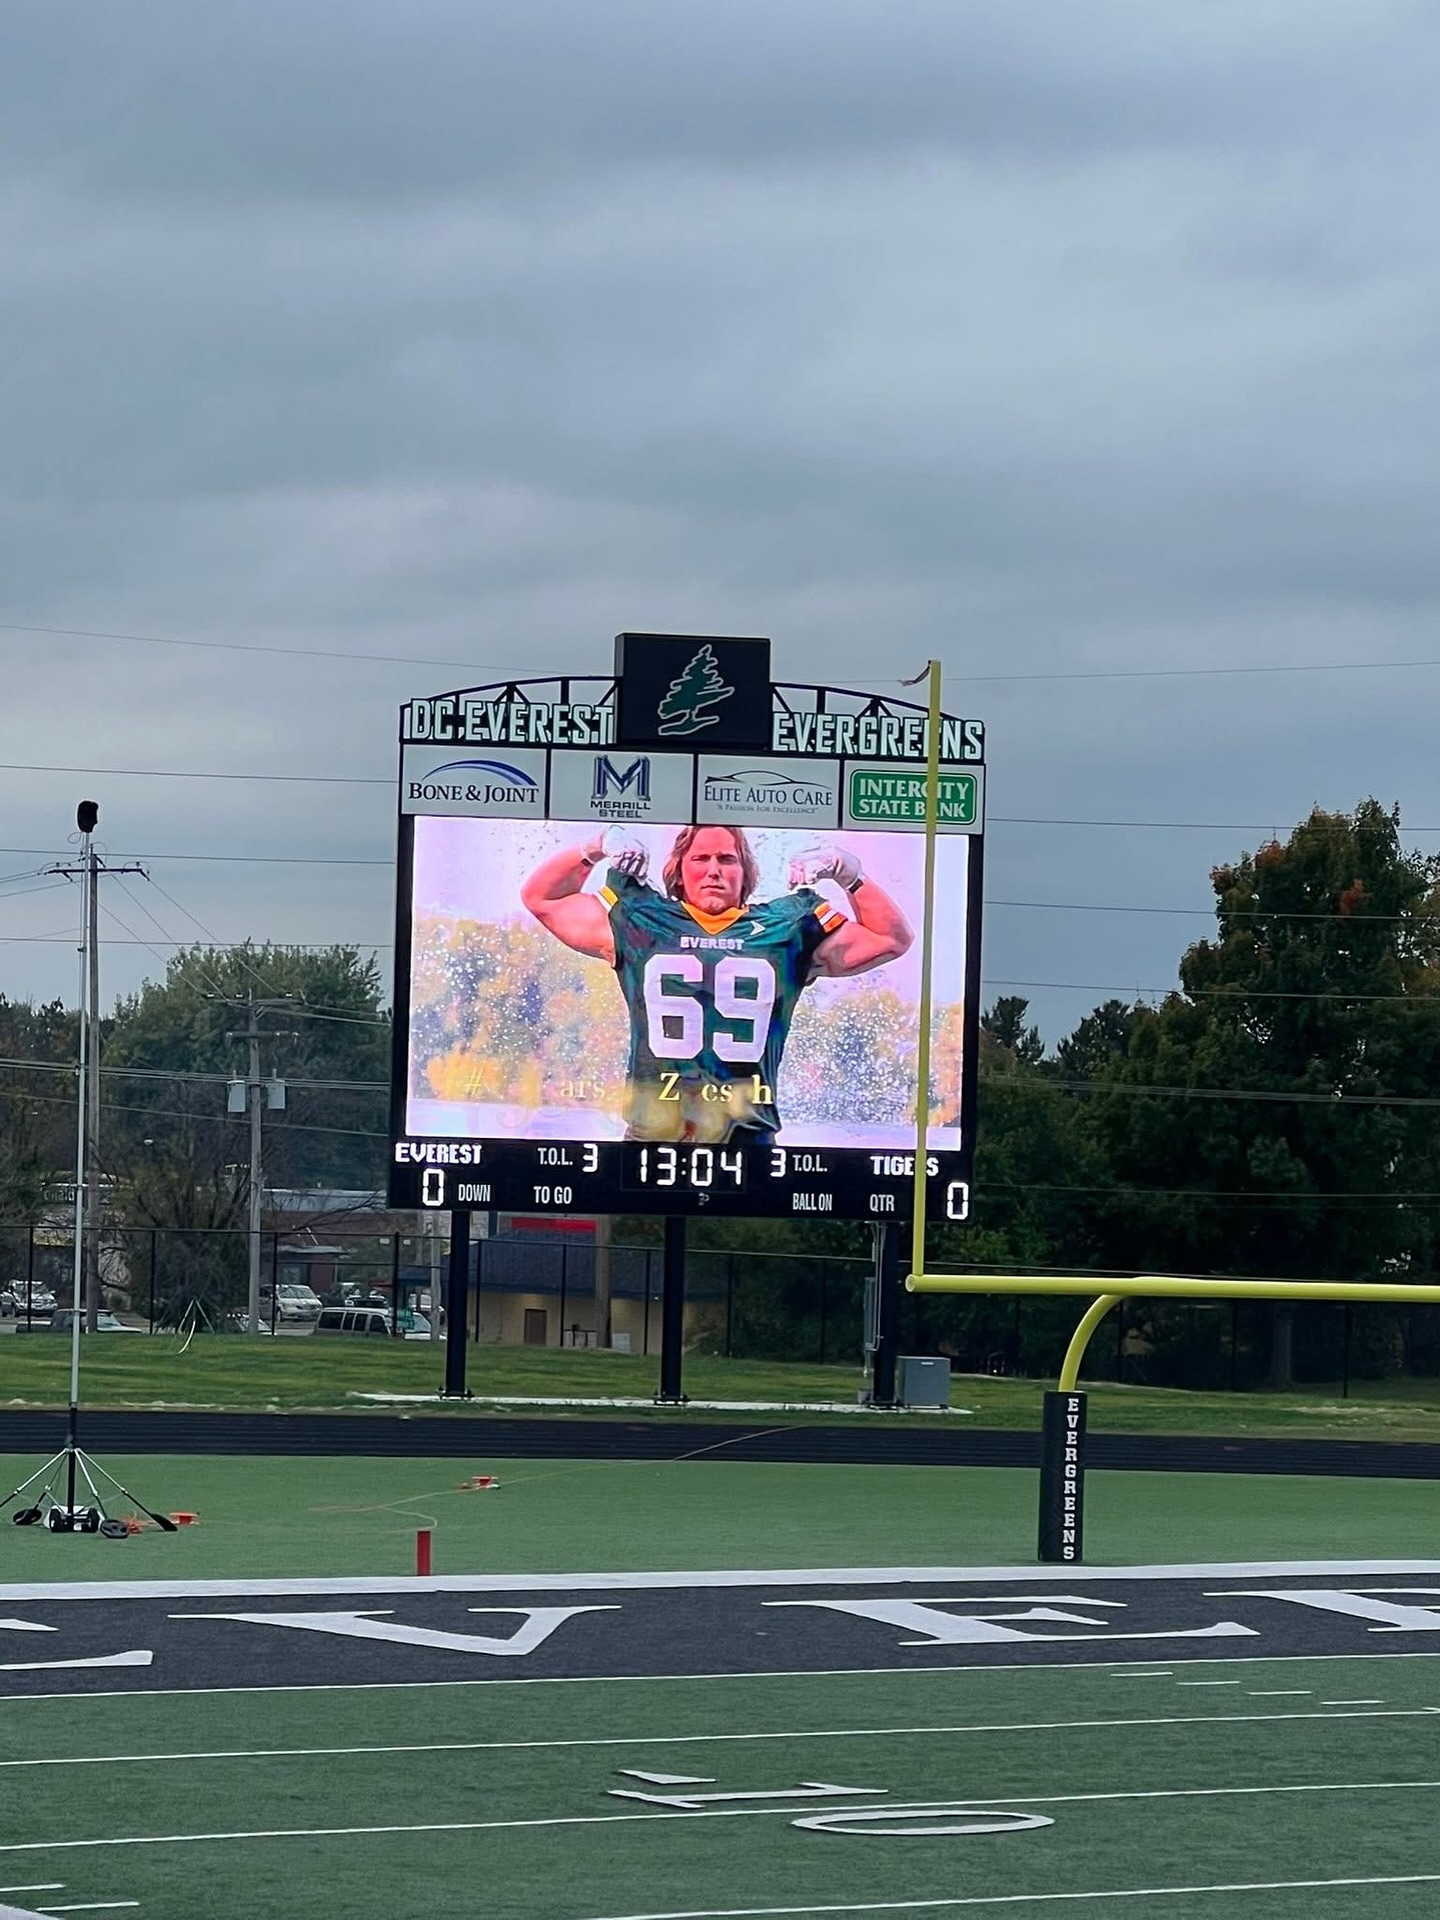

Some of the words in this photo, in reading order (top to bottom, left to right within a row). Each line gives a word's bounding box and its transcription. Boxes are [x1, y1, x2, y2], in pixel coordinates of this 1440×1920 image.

[410, 699, 456, 741] DC
[464, 701, 614, 745] EVEREST
[409, 782, 462, 800] BONE
[465, 785, 480, 801] &
[484, 785, 539, 803] JOINT
[590, 801, 651, 810] MERRILL
[599, 809, 642, 818] STEEL
[859, 798, 911, 815] STATE
[915, 801, 966, 818] BNK
[680, 936, 745, 950] EVEREST
[644, 954, 776, 1062] 69
[395, 1142, 482, 1164] EVEREST
[538, 1147, 573, 1166] T.O.L.
[582, 1143, 599, 1172] 3
[770, 1149, 787, 1177] 3
[792, 1154, 828, 1172] T.O.L.
[640, 1147, 742, 1187] 13:04
[870, 1156, 939, 1176] TIGES
[422, 1168, 445, 1207] 0
[458, 1184, 491, 1202] DOWN
[533, 1186, 551, 1204] TO
[554, 1187, 572, 1204] GO
[869, 1194, 895, 1213] QTR
[947, 1182, 969, 1220] 0
[1063, 1398, 1079, 1560] EVERGREENS
